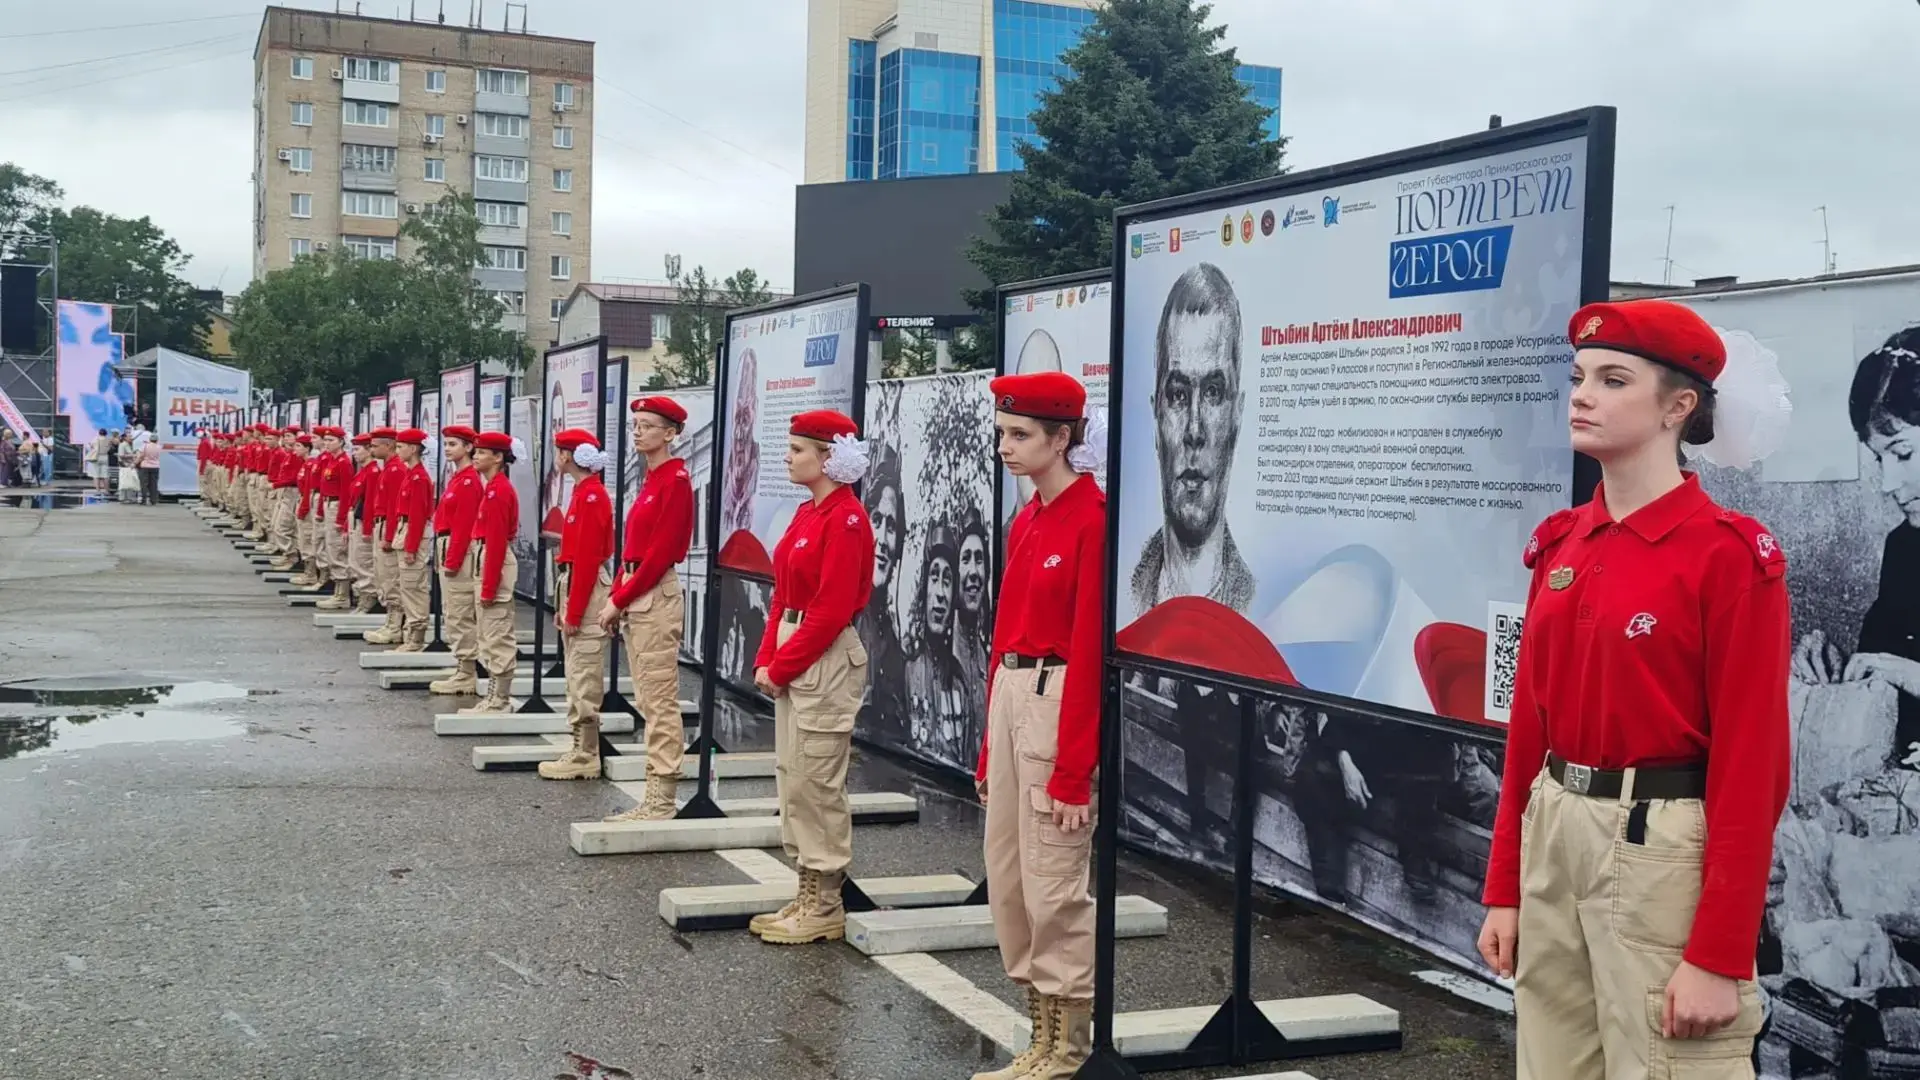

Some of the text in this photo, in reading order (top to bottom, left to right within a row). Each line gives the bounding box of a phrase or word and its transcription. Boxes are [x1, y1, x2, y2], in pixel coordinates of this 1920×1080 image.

[1397, 152, 1572, 193] Проект Губернатора Приморского края
[1395, 166, 1576, 236] ПОРТРЕТ
[1392, 235, 1496, 288] ГЕРОЯ
[886, 316, 935, 328] ТЕЛЕМИКС
[1261, 312, 1462, 346] Штыбин Артём Александрович
[1261, 352, 1281, 364] Артём
[1282, 349, 1338, 362] Александрович
[1339, 347, 1370, 359] Штыбин
[1371, 345, 1405, 358] родился
[1413, 344, 1429, 354] мая
[1431, 341, 1449, 353] 1992
[1450, 341, 1472, 352] года
[1473, 341, 1479, 350] в
[1480, 339, 1514, 352] городе
[1260, 367, 1266, 378] В
[1266, 367, 1283, 378] 2007
[1283, 368, 1299, 379] году
[1300, 365, 1330, 376] окончил
[1330, 364, 1336, 375] 9
[1336, 363, 1368, 375] классов
[1369, 365, 1375, 373] и
[1376, 362, 1414, 374] поступил
[1415, 362, 1420, 371] в
[1422, 356, 1485, 371] Региональный
[168, 385, 239, 394] МЕЖДУНАРОДНЫЙ
[1259, 373, 1543, 394] колледж, получил специальность помощника машиниста электровоза.
[169, 397, 238, 416] ДЕНЬ
[1259, 389, 1559, 408] В 2010 году Артём ушёл в армию, по окончании службы вернулся в родной
[1258, 413, 1280, 424] город.
[1258, 426, 1503, 440] 23 сентября 2022 года мобилизован и направлен в служебную
[1257, 443, 1465, 456] командировку в зону специальной военной операции.
[1257, 456, 1473, 473] Был командиром отделения, оператором беспилотника.
[1256, 472, 1562, 494] 7 марта 2023 года младший сержант Штыбин в результате массированного
[1256, 488, 1524, 510] авиаудара противника получил ранение, несовместимое с жизнью.
[1295, 505, 1327, 516] орденом
[1328, 505, 1365, 518] Мужества
[1366, 507, 1417, 521] (посмертно).
